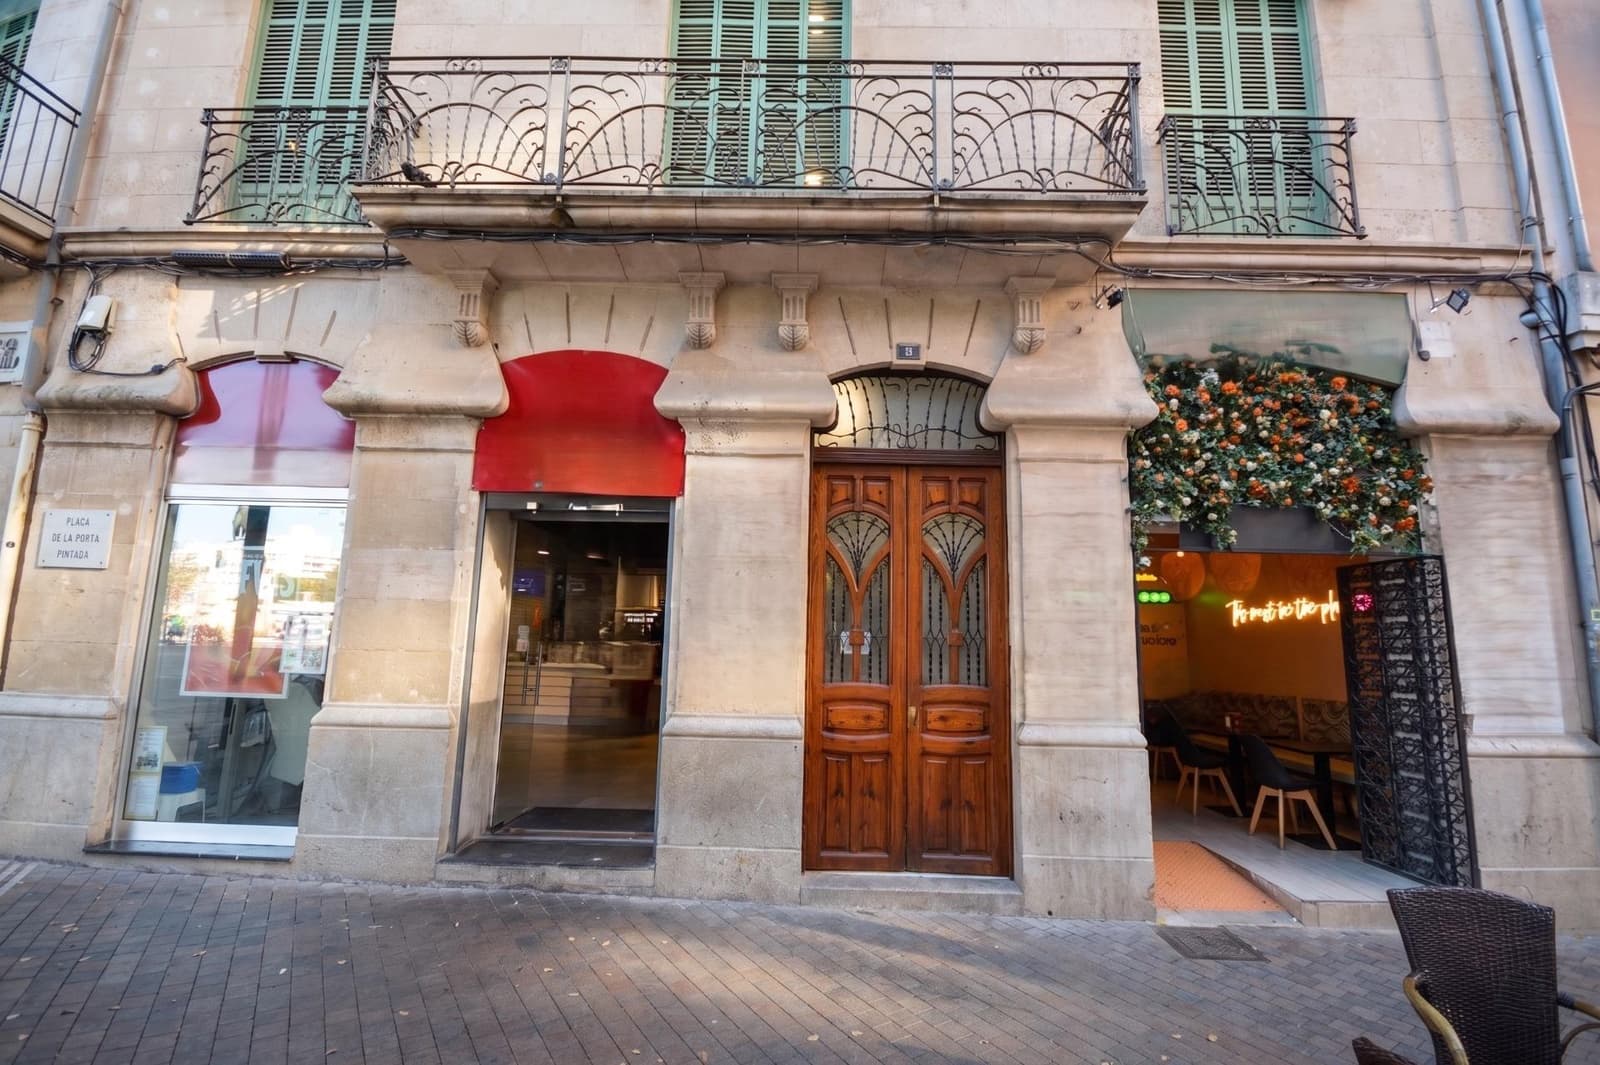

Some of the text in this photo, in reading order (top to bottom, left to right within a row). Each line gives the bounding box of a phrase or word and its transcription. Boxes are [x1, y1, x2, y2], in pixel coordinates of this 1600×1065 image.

[52, 533, 100, 543] DE LA PORTA
[56, 549, 89, 559] PINTADA
